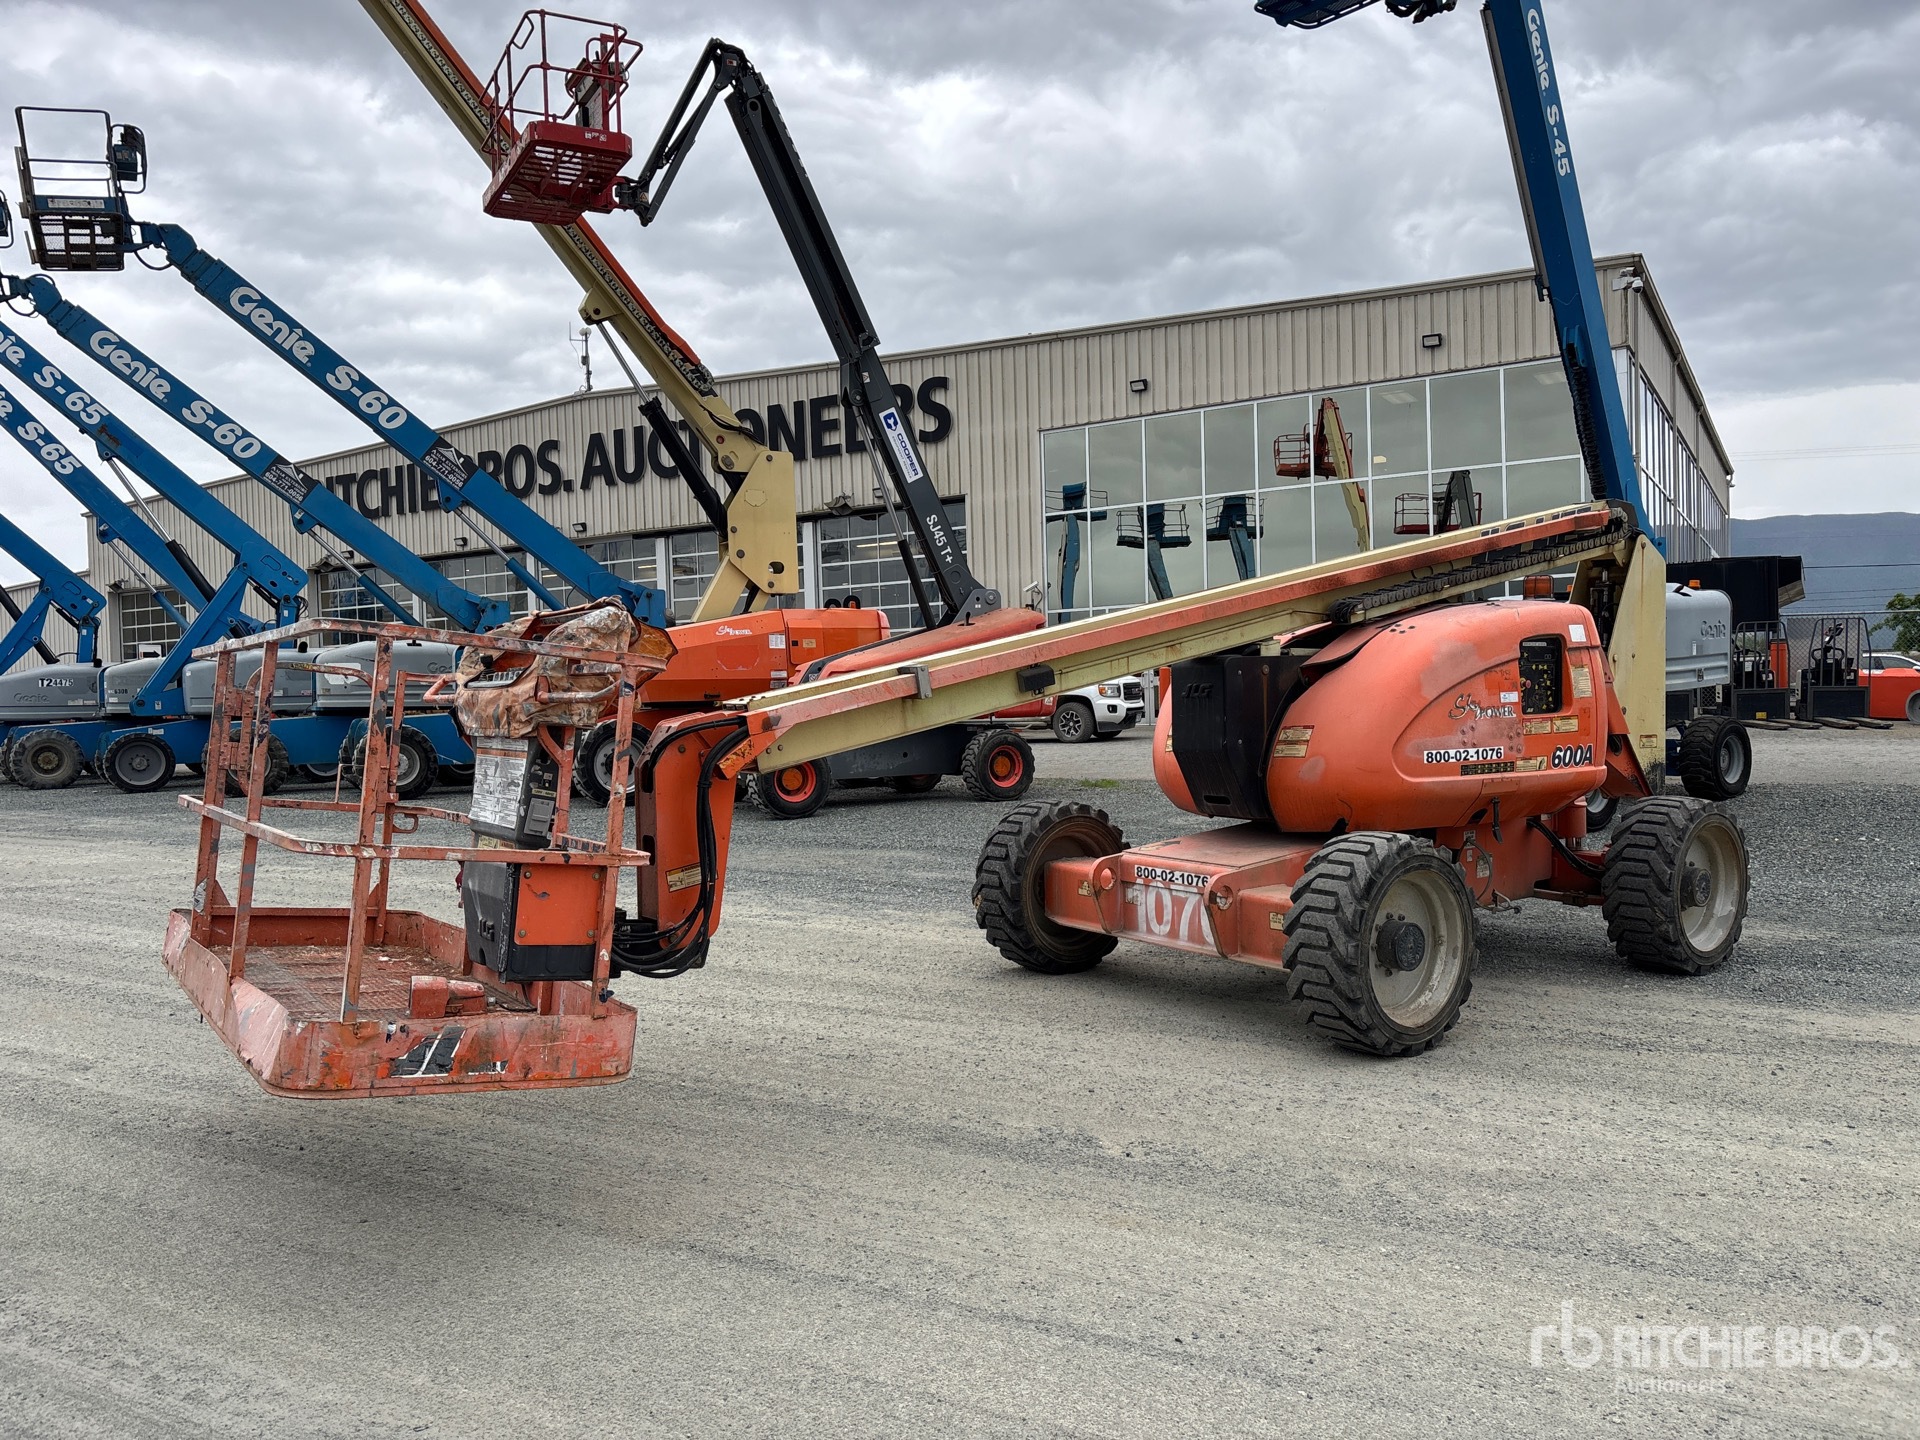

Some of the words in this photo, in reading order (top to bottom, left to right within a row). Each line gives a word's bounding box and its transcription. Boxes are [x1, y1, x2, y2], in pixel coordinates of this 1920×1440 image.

[1527, 8, 1550, 91] Genie
[1547, 104, 1571, 177] S-45
[229, 286, 315, 364] Genie
[325, 365, 408, 429] S-60
[33, 365, 110, 425] S-65
[89, 330, 171, 400] Genie
[181, 400, 261, 459] S-60
[17, 421, 83, 475] S-65
[424, 455, 464, 487] 604-771-0056
[896, 432, 919, 477] COOPER
[314, 463, 441, 520] TCHIE
[462, 439, 572, 499] ROS.
[926, 514, 948, 547] SJ45
[940, 545, 954, 564] T+
[1181, 682, 1214, 699] JLG
[1426, 747, 1503, 763] 800-02-1076
[1551, 744, 1593, 769] 600A
[1136, 866, 1208, 887] 800-02-1076
